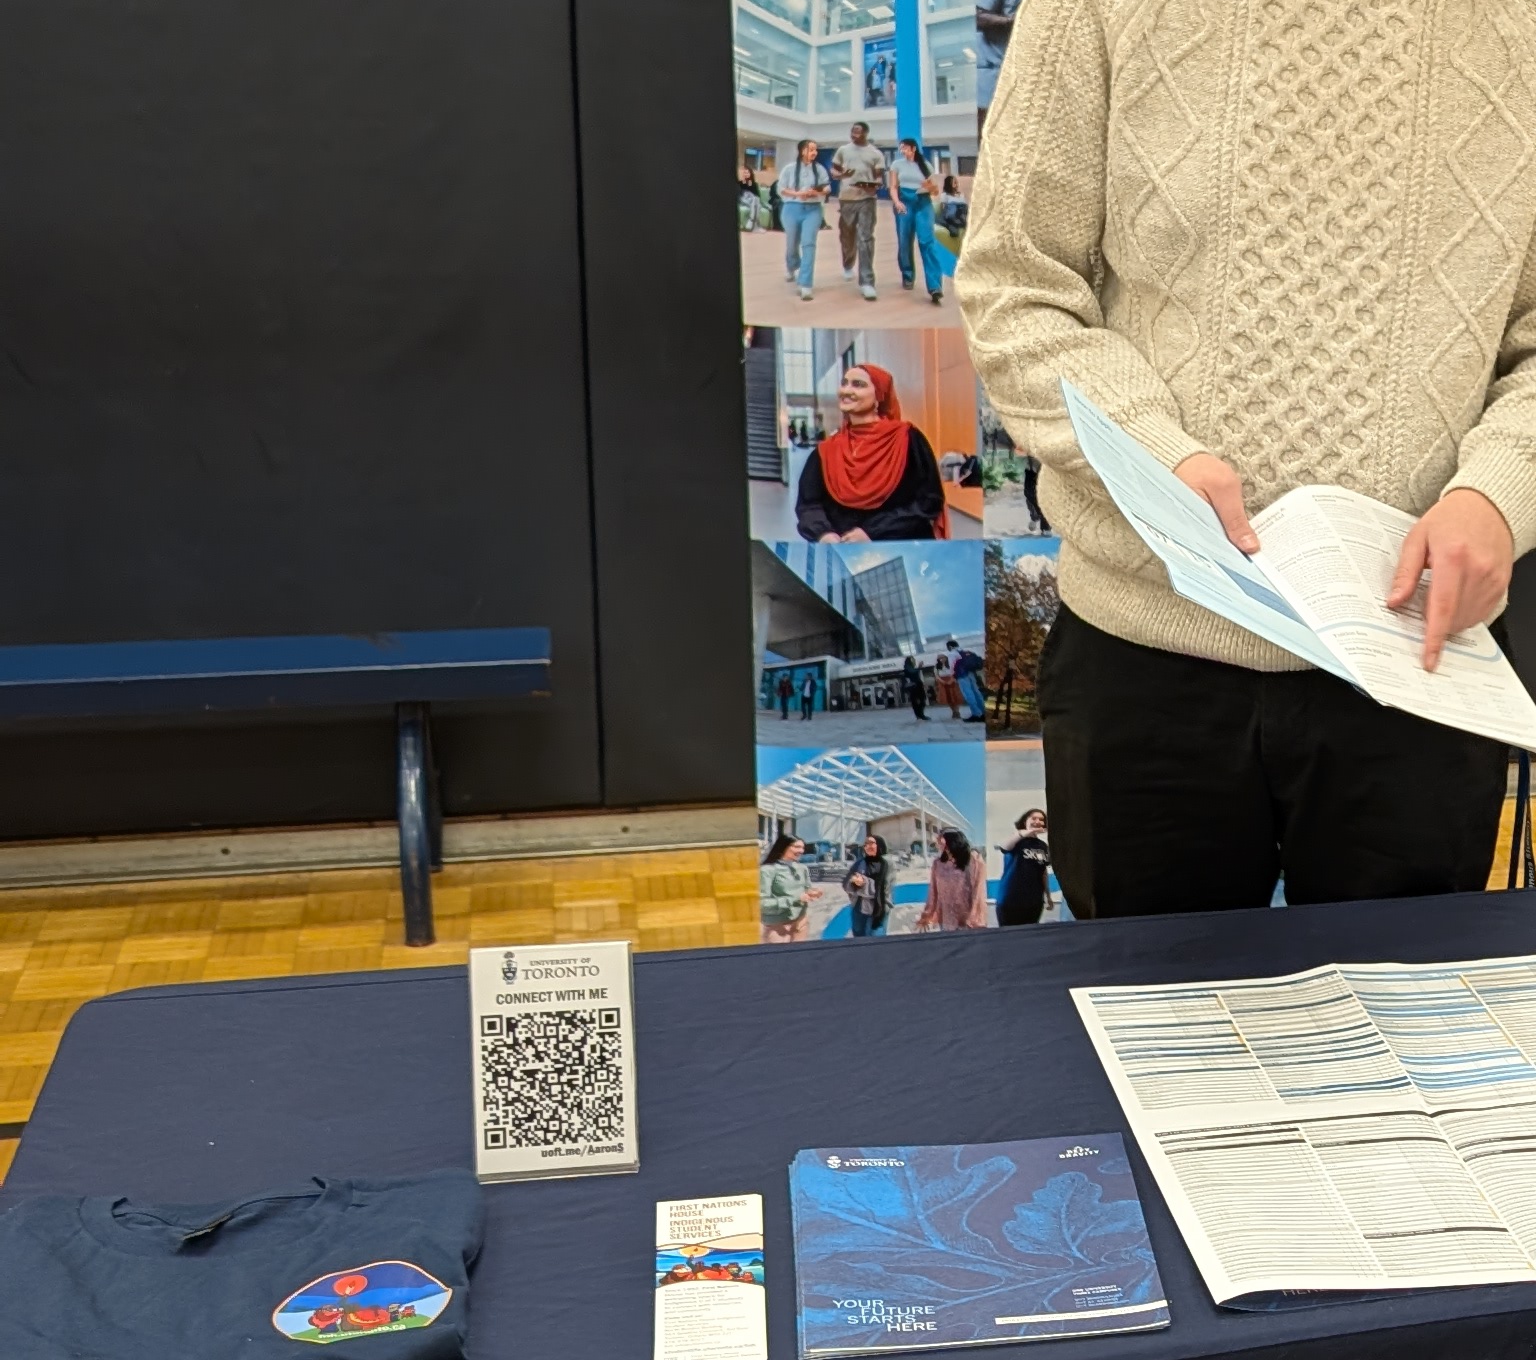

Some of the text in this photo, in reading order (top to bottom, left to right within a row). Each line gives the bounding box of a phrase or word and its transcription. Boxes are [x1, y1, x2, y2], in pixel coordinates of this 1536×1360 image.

[530, 958, 578, 966] UNIVERSITY
[521, 965, 600, 980] TORONTO
[496, 988, 609, 1005] CONNECT WITH ME
[670, 1200, 748, 1211] FIRST NATIONS
[669, 1209, 705, 1218] HOUSE
[669, 1216, 734, 1226] INDIGENOUS
[669, 1224, 718, 1233] STUDENT
[669, 1230, 722, 1240] SERVICES
[833, 1300, 884, 1309] YOUR
[861, 1306, 936, 1316] FUTURE
[847, 1314, 917, 1324] STARTS
[887, 1322, 938, 1332] HERE
